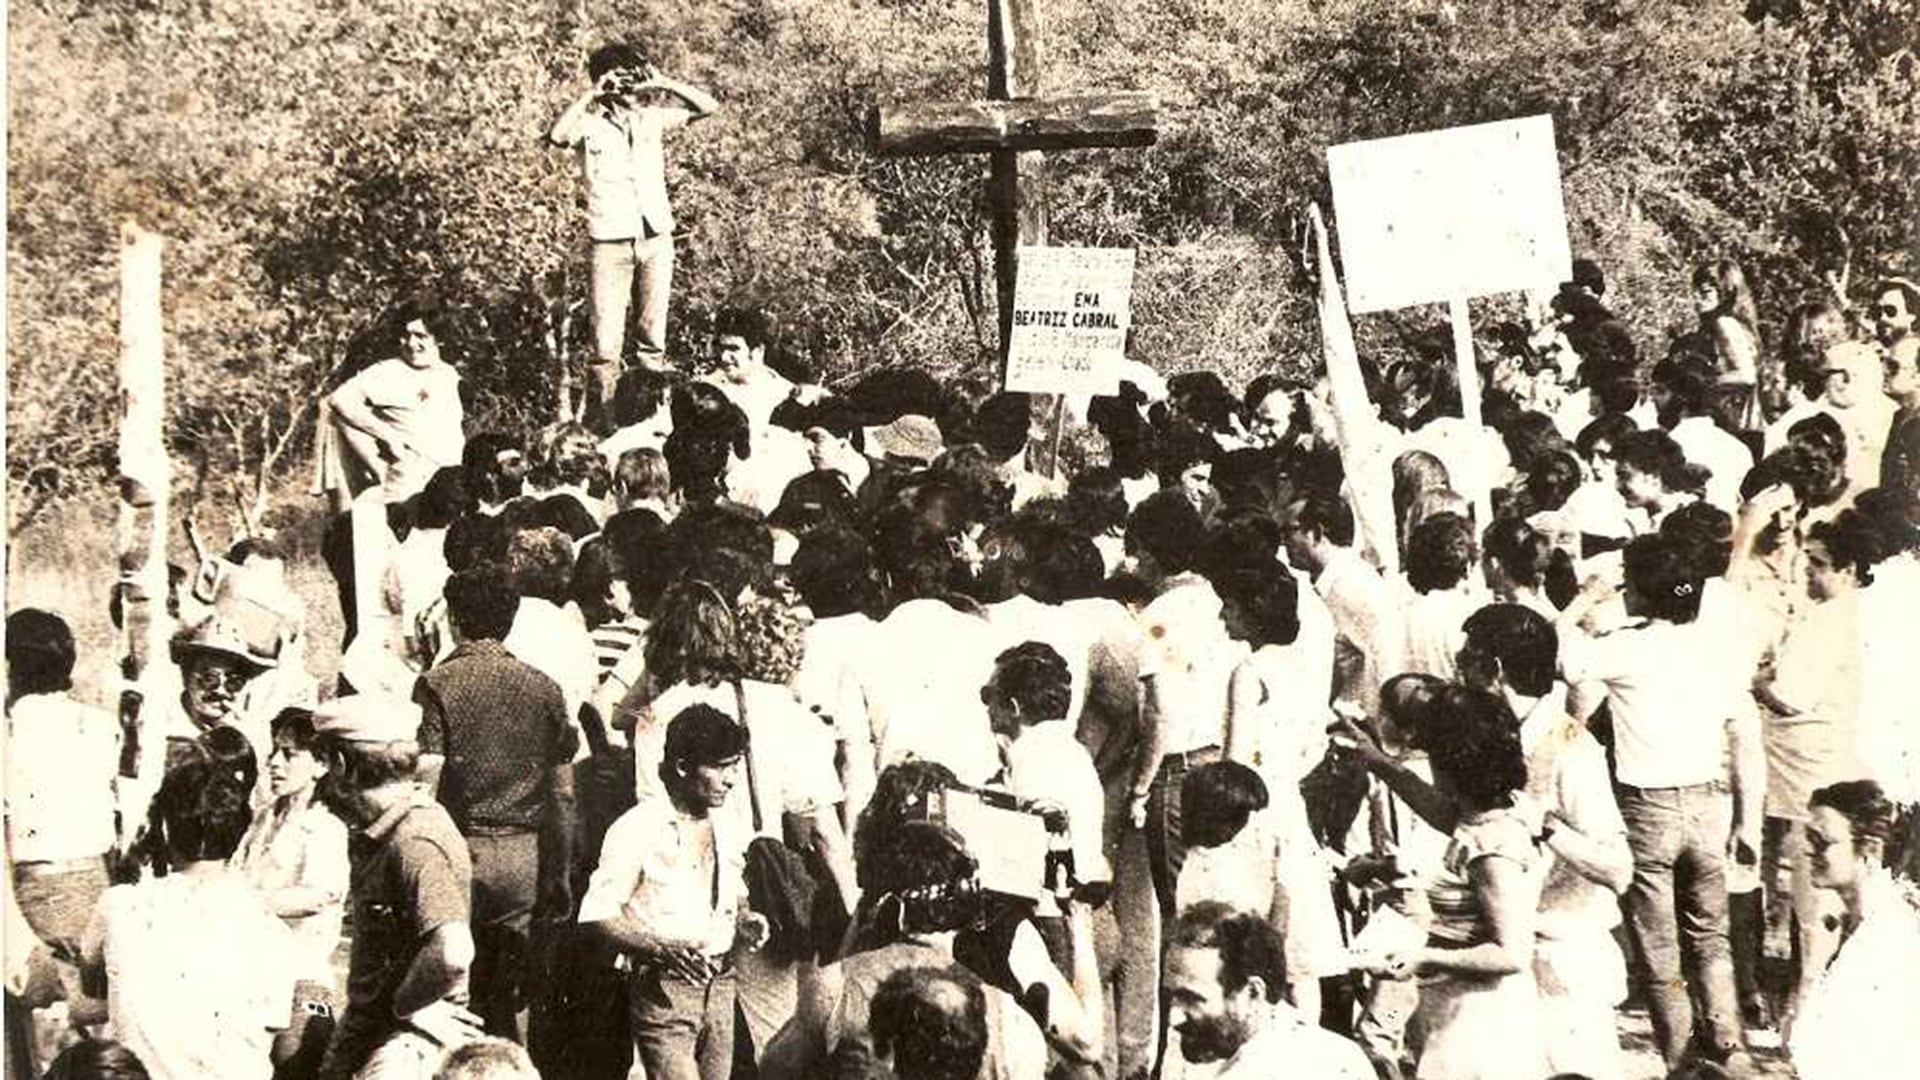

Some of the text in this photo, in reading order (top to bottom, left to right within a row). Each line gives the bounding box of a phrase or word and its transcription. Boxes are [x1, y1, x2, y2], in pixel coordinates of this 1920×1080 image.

[1074, 292, 1100, 308] EMA
[1014, 310, 1119, 329] BEATRIZ CABRAL
